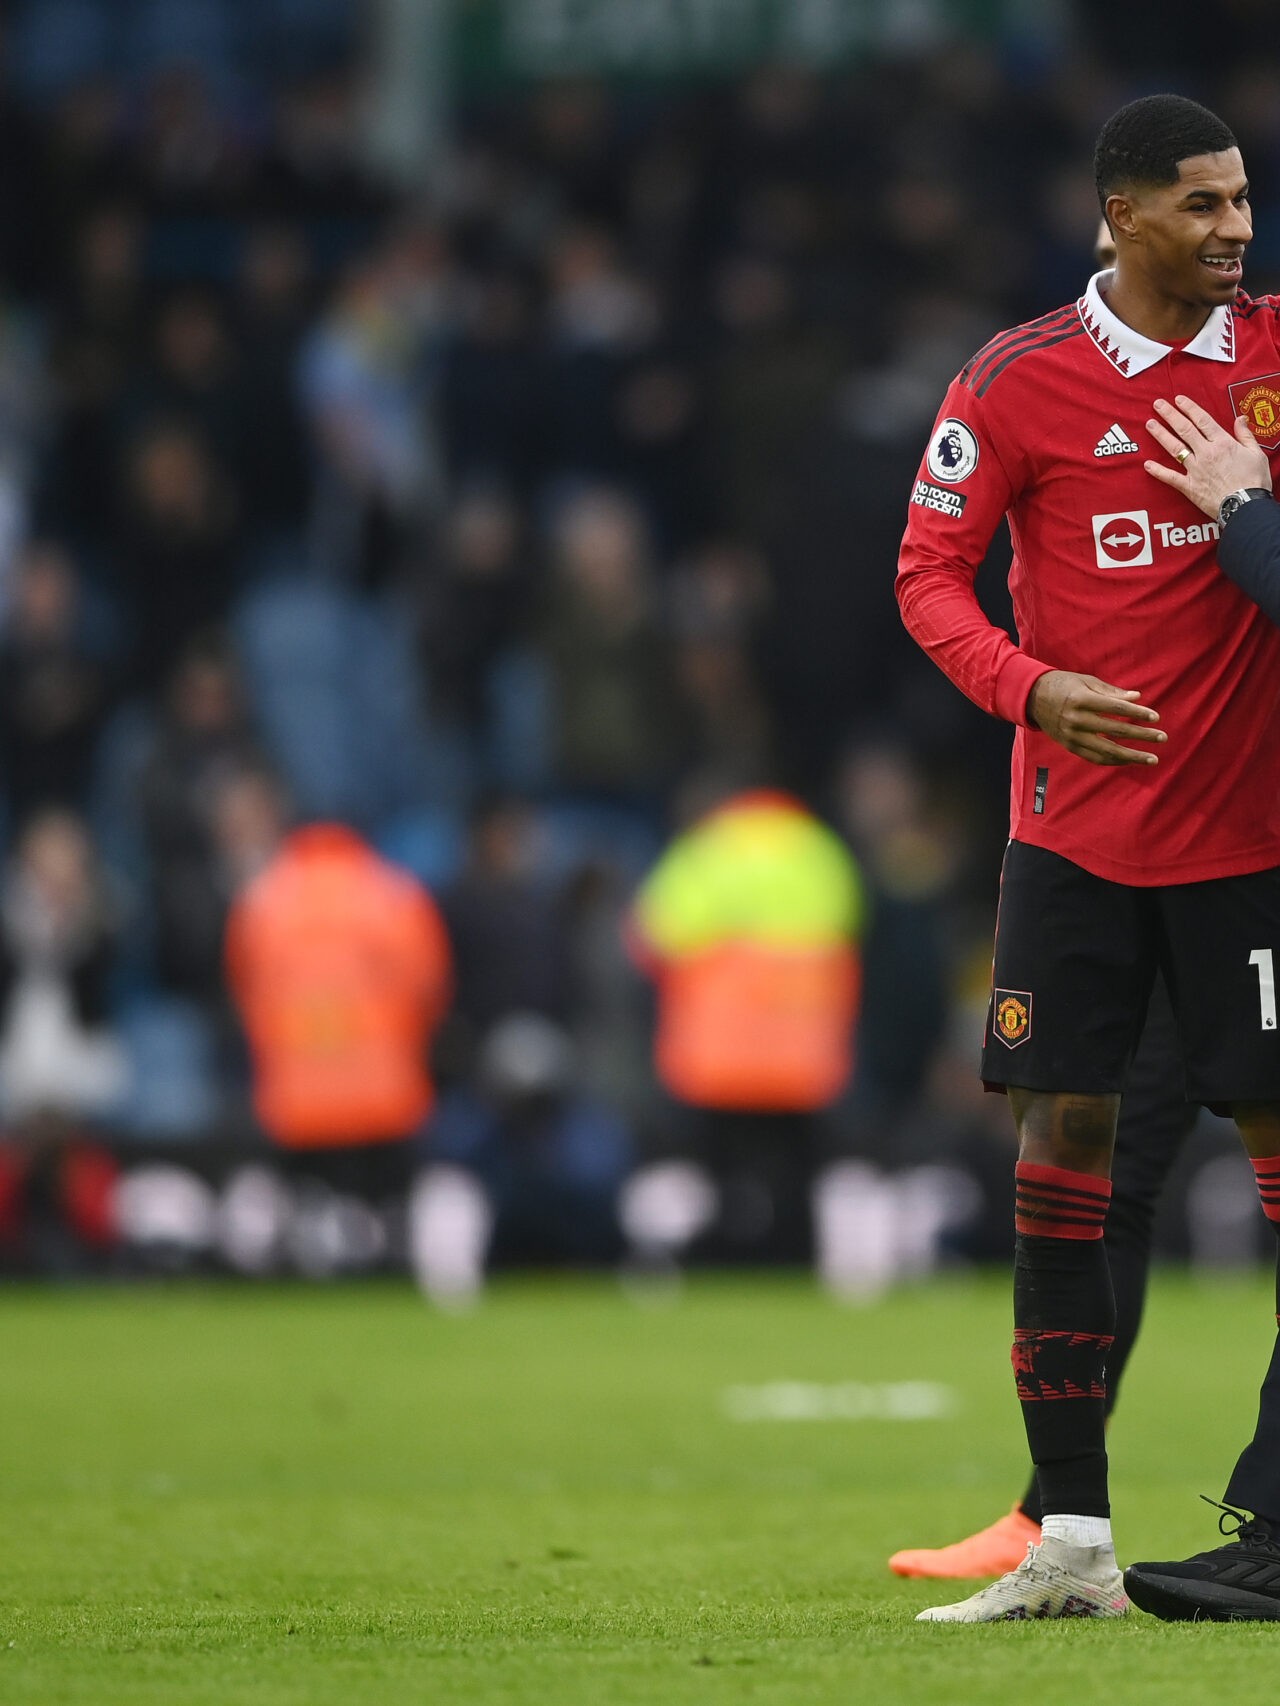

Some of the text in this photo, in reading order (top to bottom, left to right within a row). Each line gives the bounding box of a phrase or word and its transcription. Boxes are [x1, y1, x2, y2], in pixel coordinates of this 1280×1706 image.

[1243, 388, 1280, 409] MANCHESTER
[1255, 422, 1280, 434] UNITED
[1094, 442, 1138, 457] adidas
[916, 480, 960, 506] No room
[911, 491, 962, 518] for racism
